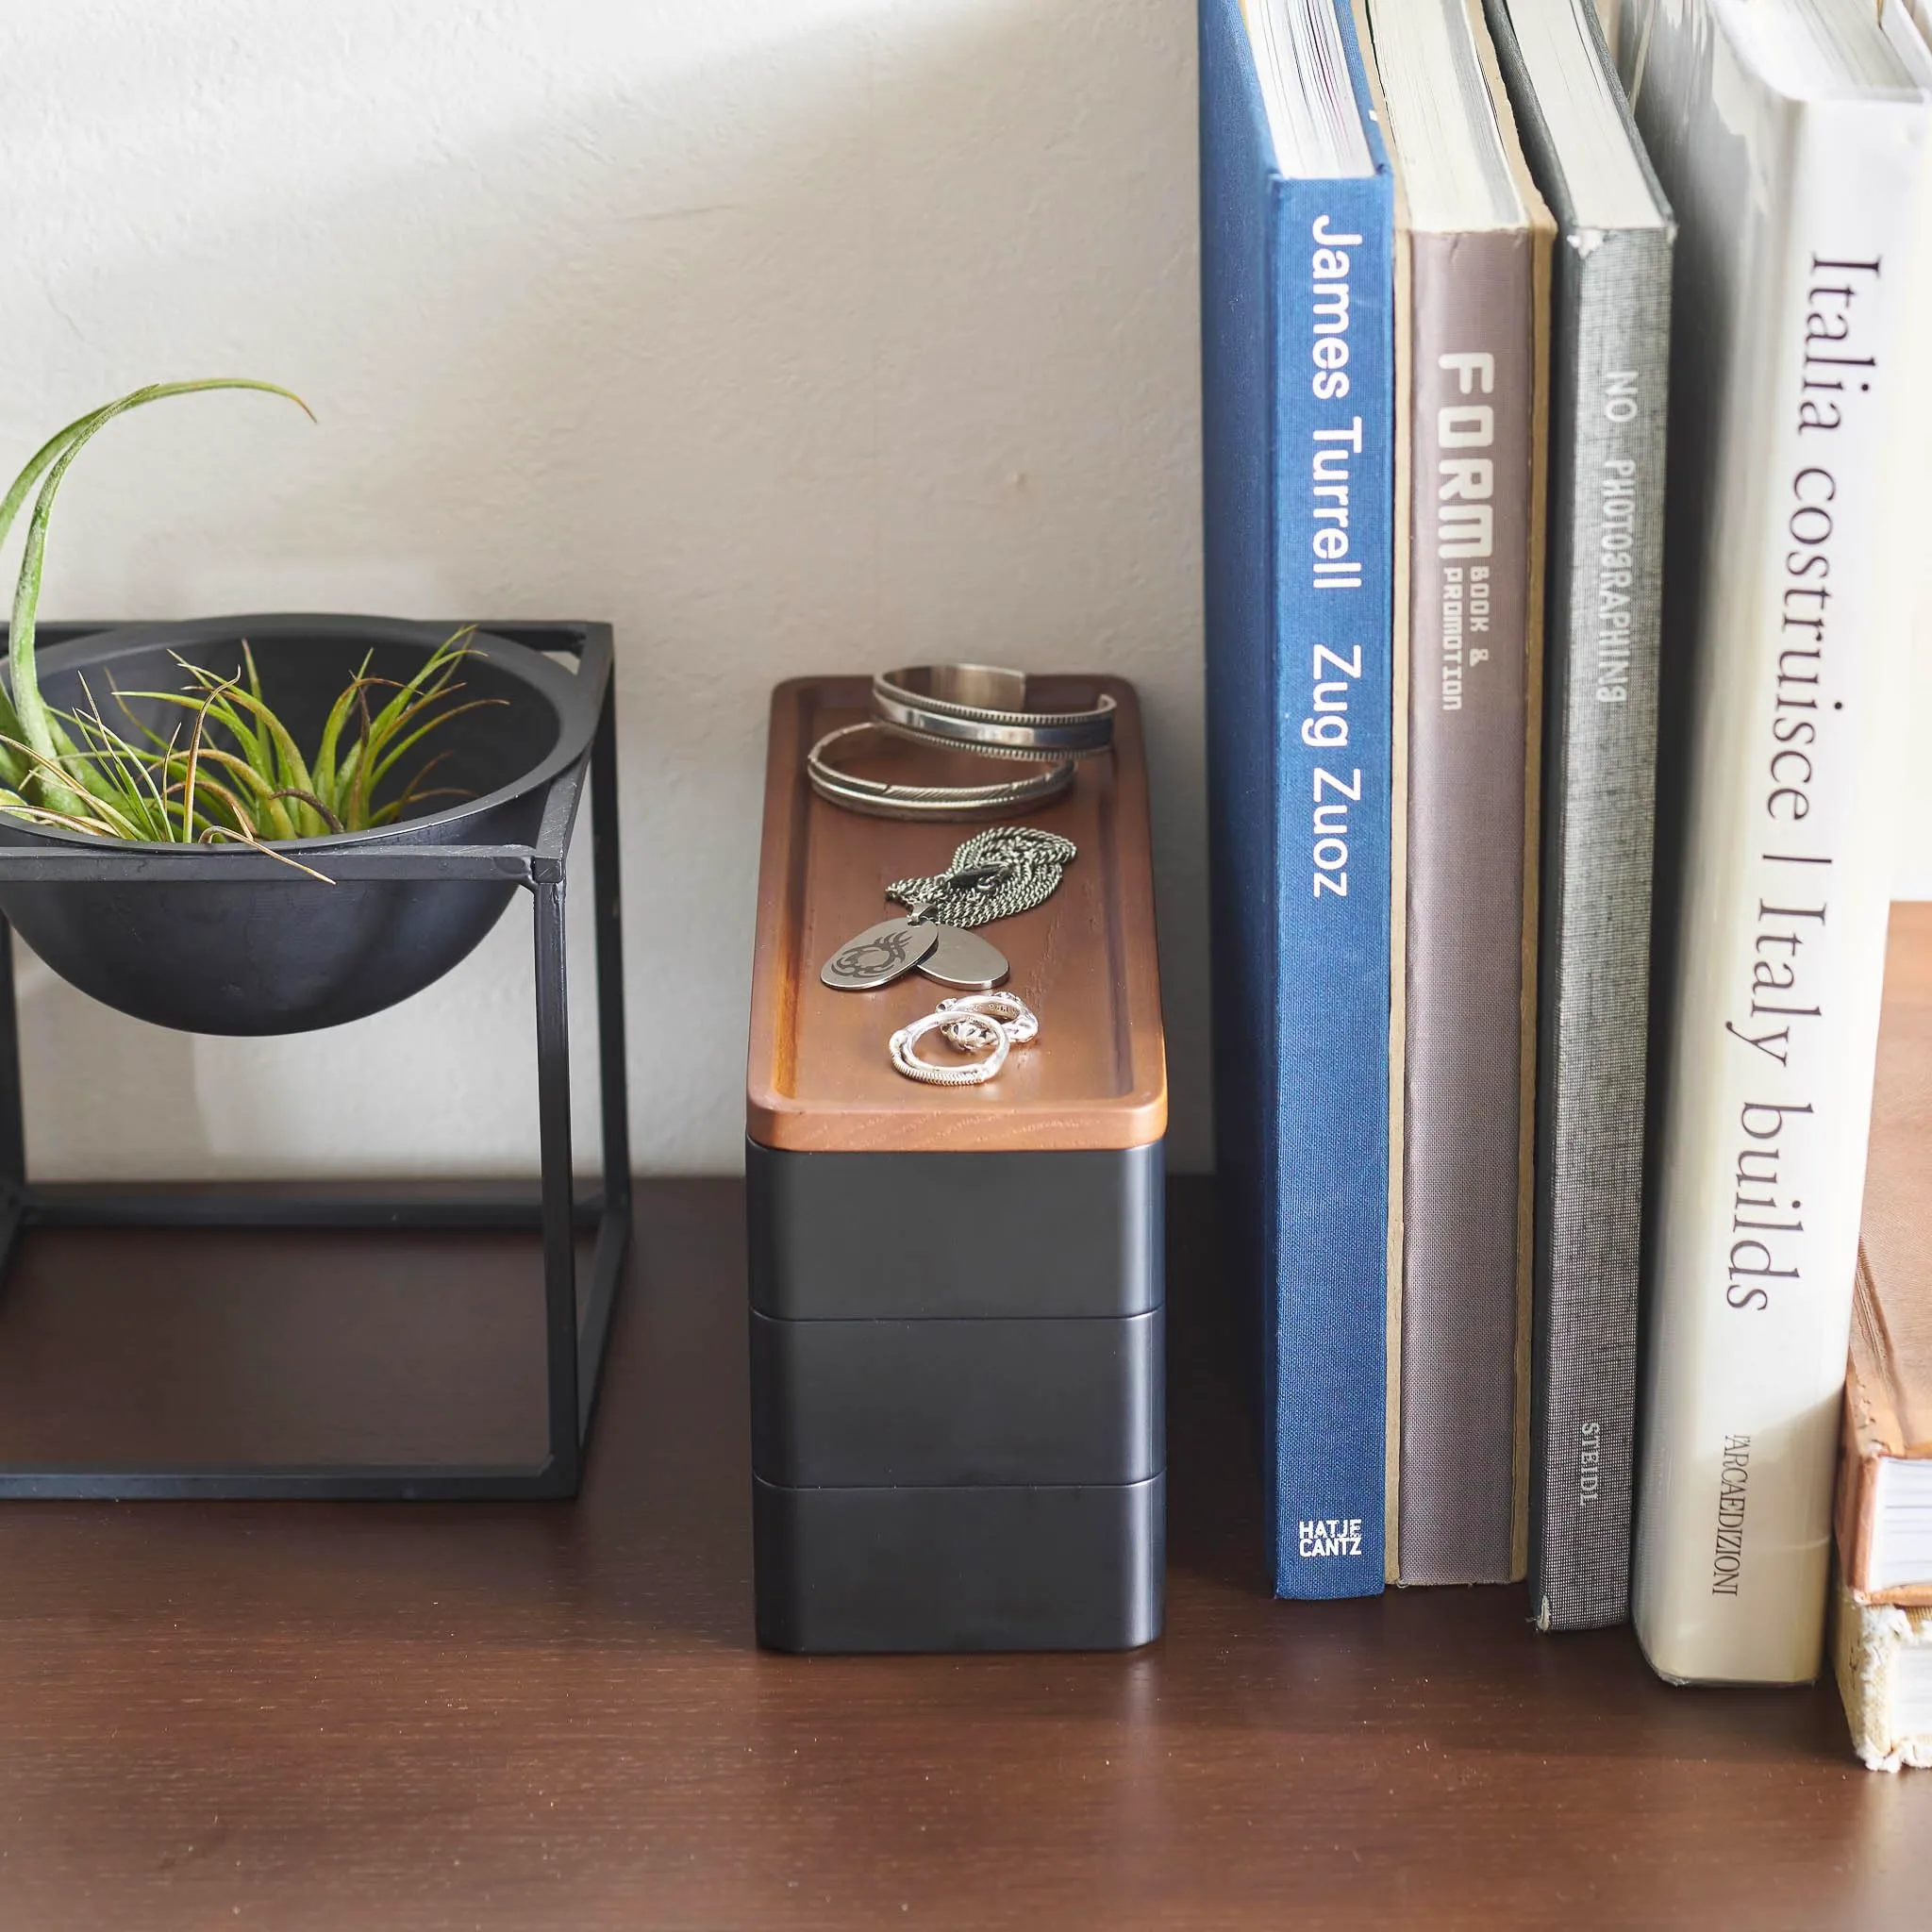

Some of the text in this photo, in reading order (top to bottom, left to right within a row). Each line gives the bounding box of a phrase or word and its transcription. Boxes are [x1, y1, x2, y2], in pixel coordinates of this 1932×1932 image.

[1604, 370, 1640, 424] NO
[1798, 252, 1882, 436] Italia
[1438, 352, 1494, 558] FORM
[1302, 215, 1362, 898] James Turrell Zug Zuoz
[1469, 566, 1490, 667] BOOK &
[1442, 567, 1463, 710] PROMOTION
[1767, 468, 1843, 821] costruisce
[1725, 898, 1827, 1068] Italy
[1725, 1101, 1814, 1312] builds
[1299, 1519, 1362, 1540] HATJE
[1577, 1422, 1601, 1507] STEIDL
[1299, 1539, 1362, 1557] CANTZ
